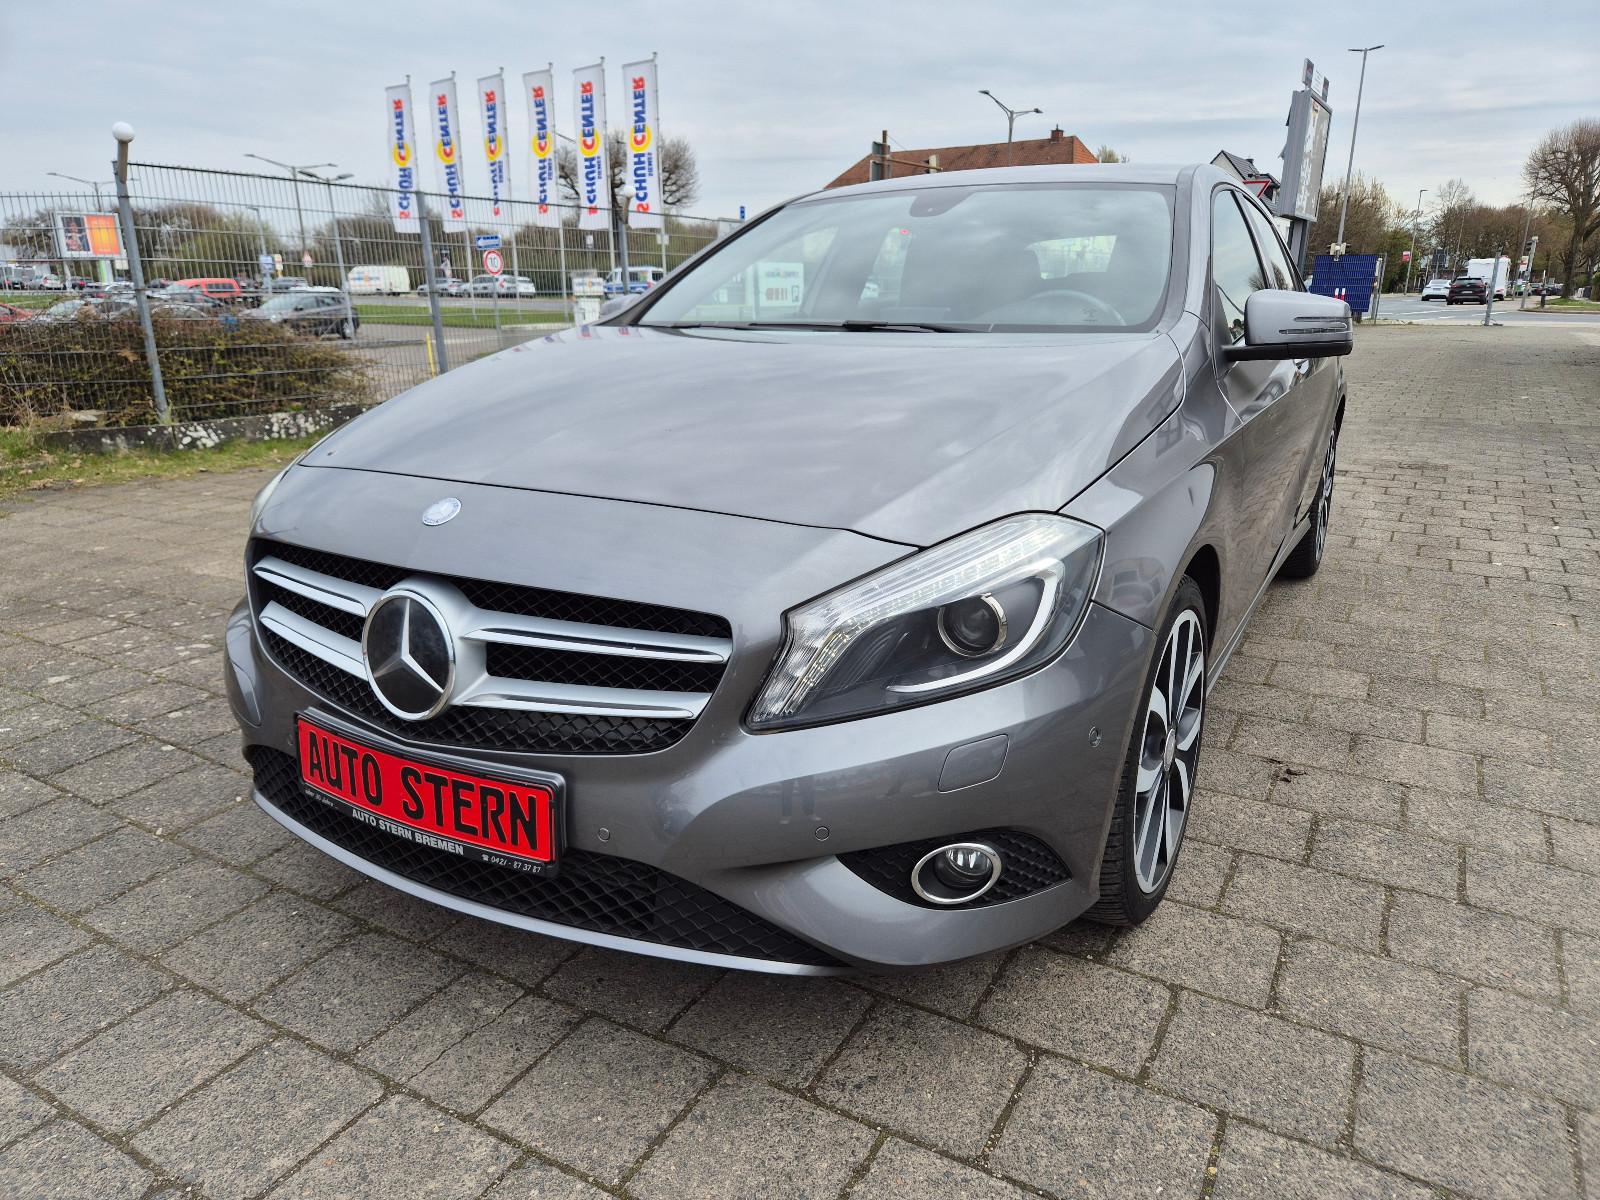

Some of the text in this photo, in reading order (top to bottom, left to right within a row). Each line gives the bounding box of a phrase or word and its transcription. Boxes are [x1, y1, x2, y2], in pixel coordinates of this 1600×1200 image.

[309, 731, 538, 850] AUTO STERN
[352, 808, 464, 856] AUTO STERN BREMEN
